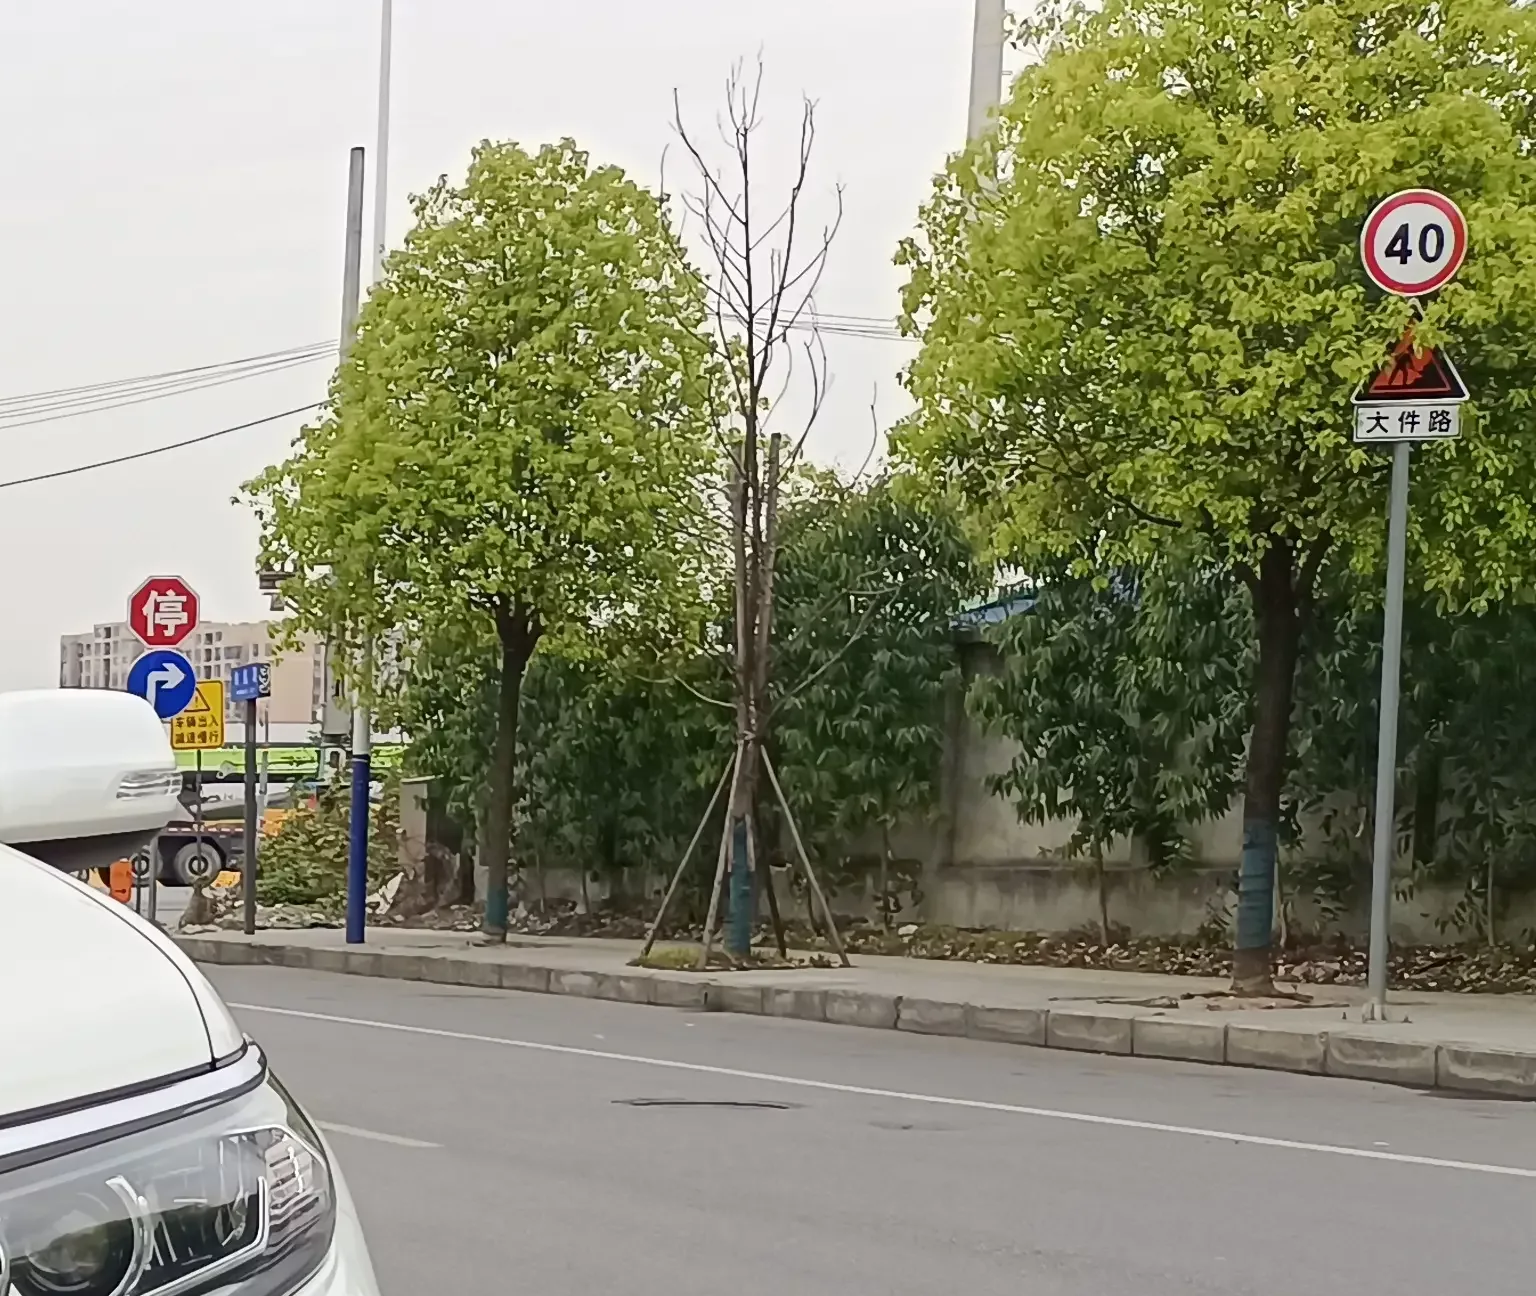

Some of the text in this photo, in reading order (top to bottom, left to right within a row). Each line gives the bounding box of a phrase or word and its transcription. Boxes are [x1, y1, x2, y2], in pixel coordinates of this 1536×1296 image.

[1384, 223, 1444, 265] 40
[1366, 410, 1452, 433] 大件路
[143, 589, 188, 636] 停
[175, 714, 219, 729] 车辆出入
